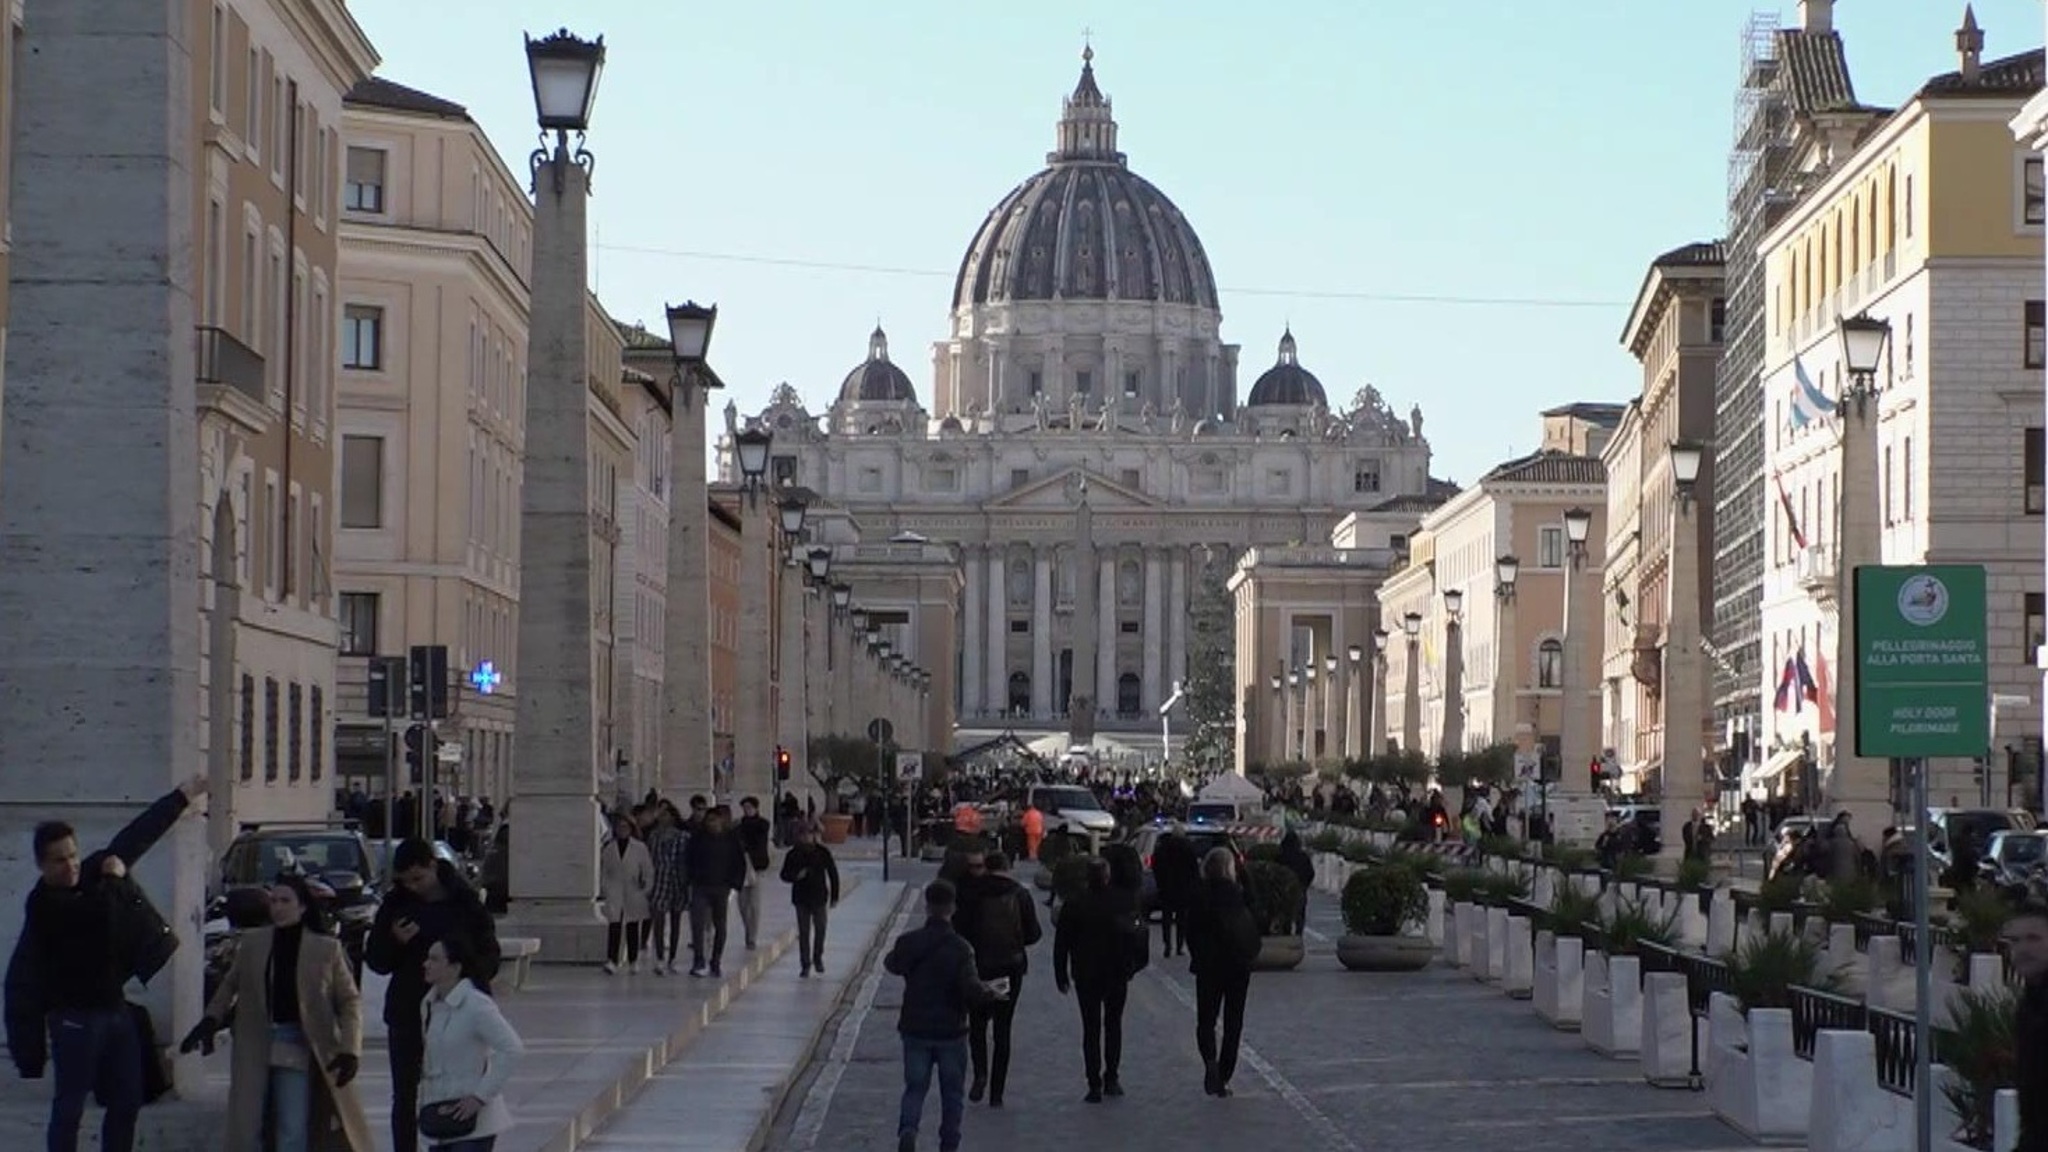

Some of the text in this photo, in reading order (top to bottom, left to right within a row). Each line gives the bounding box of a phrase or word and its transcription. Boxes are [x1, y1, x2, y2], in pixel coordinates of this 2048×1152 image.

[1872, 640, 1977, 652] PELLEGRINAGGIO
[1867, 654, 1982, 666] ALLA PORTA SANTA
[1892, 707, 1957, 718] HOLY DOOR
[1890, 723, 1960, 734] PILGRIMAGE
